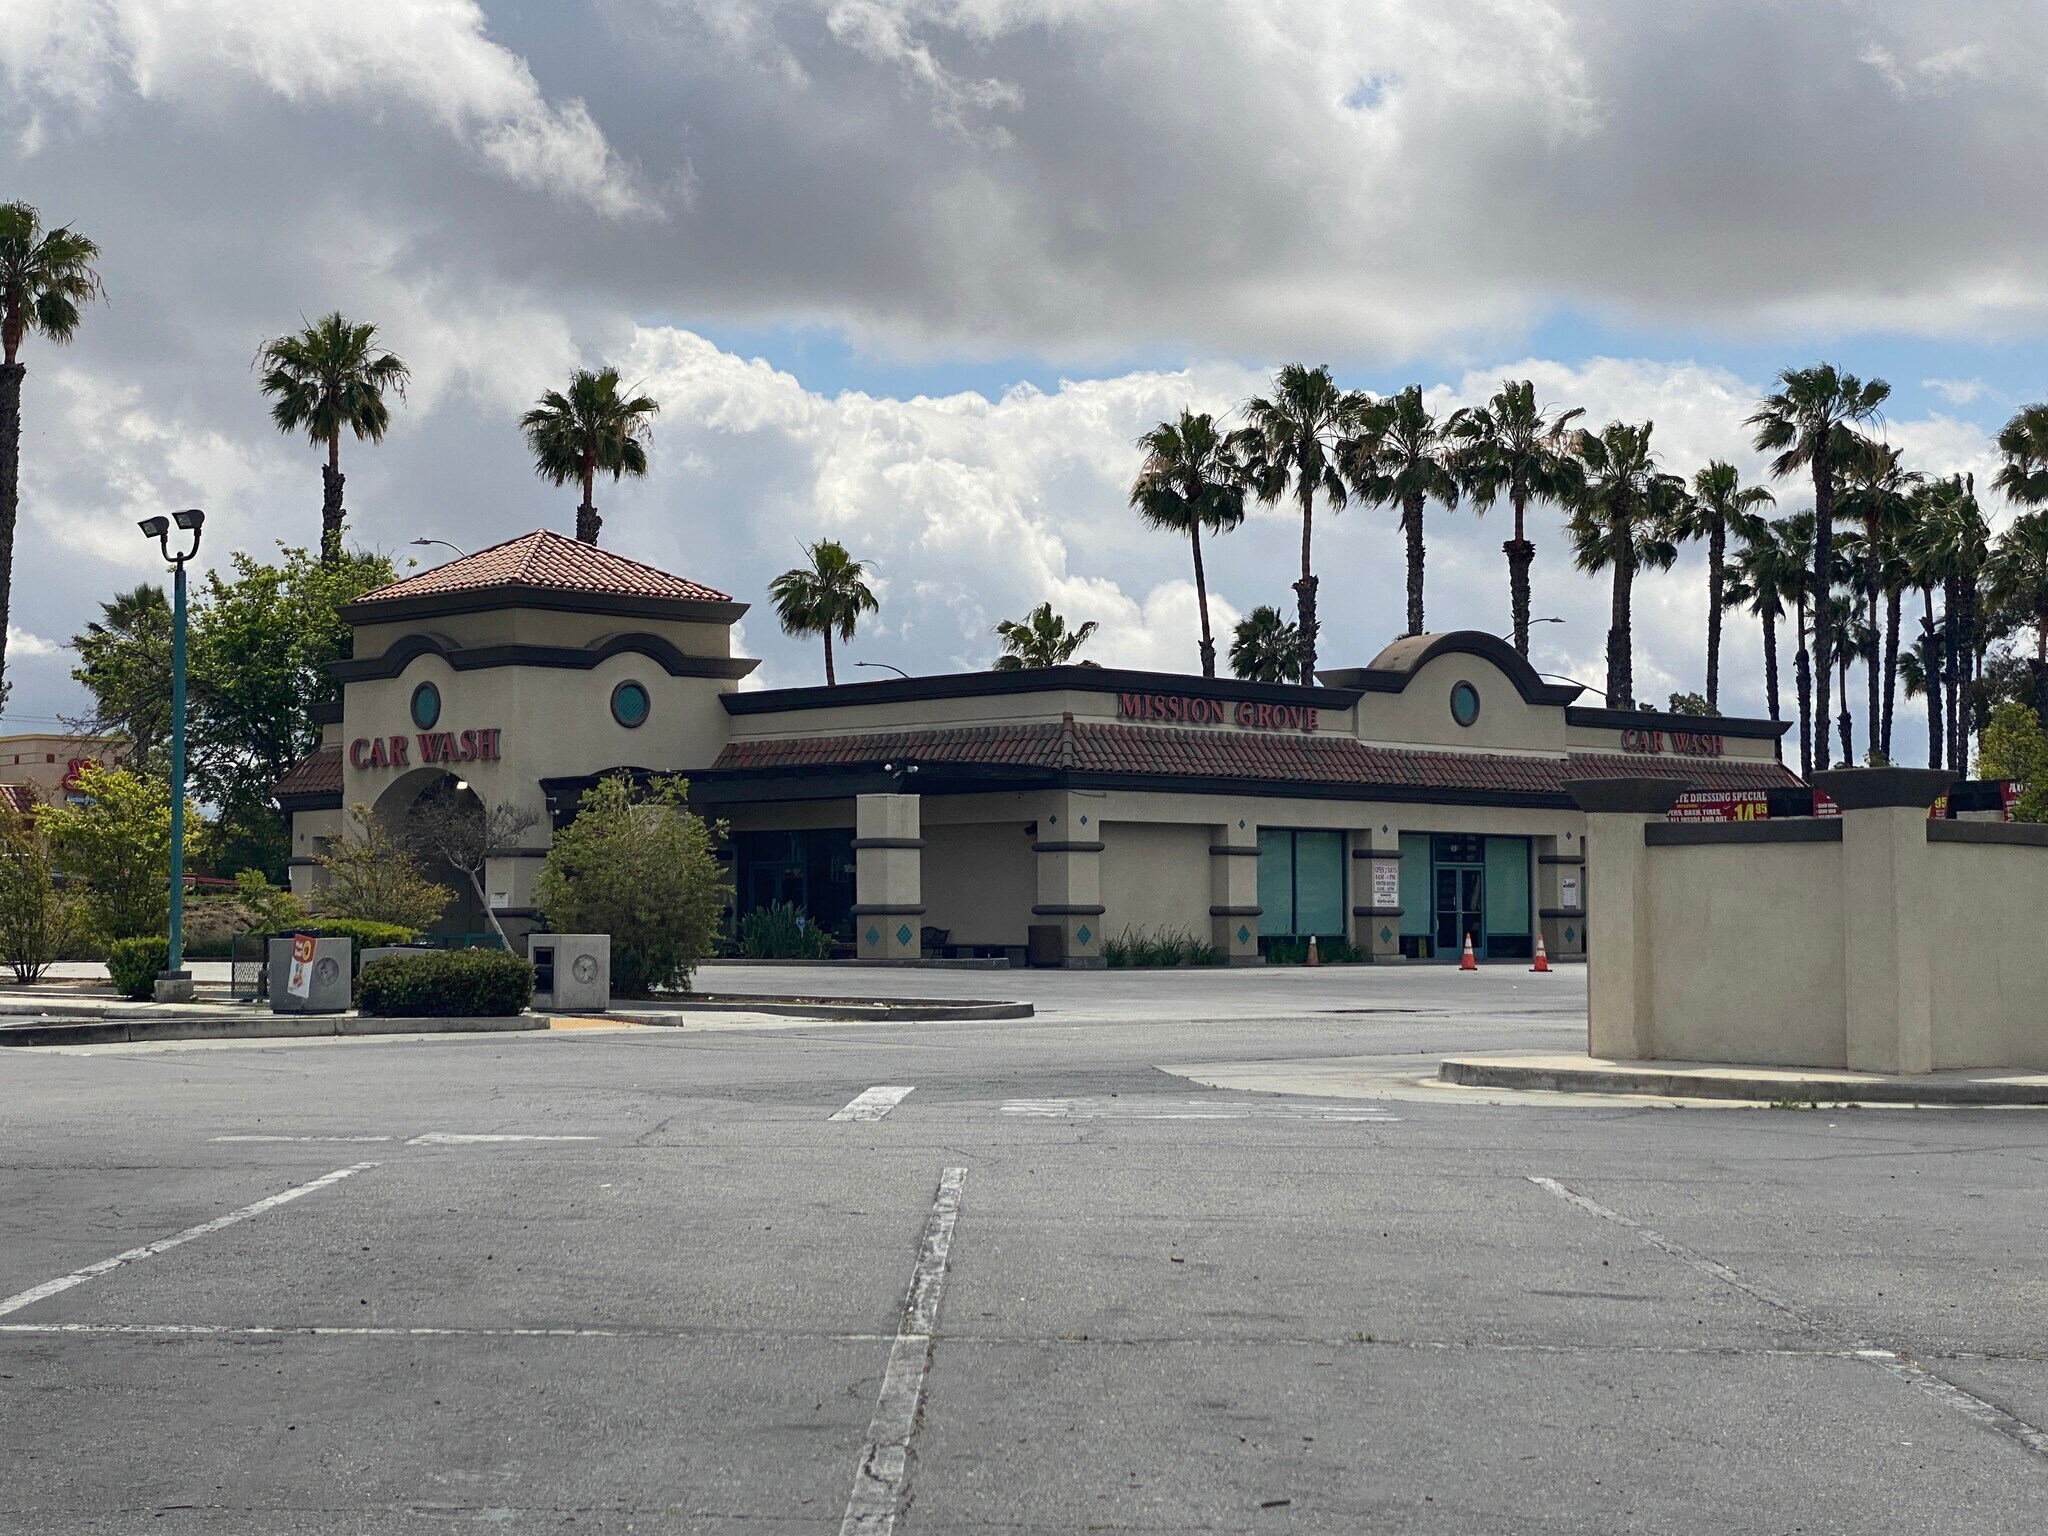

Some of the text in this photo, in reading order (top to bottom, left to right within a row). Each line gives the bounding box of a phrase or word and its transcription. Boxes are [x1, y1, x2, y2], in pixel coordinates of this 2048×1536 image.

[1118, 693, 1319, 731] MISSION GROVE
[350, 728, 502, 769] CAR WASH
[1622, 729, 1725, 755] CAR WASH
[1690, 793, 1731, 803] DRESSING
[1732, 791, 1767, 800] SPECIAL
[1756, 803, 1767, 814] 95
